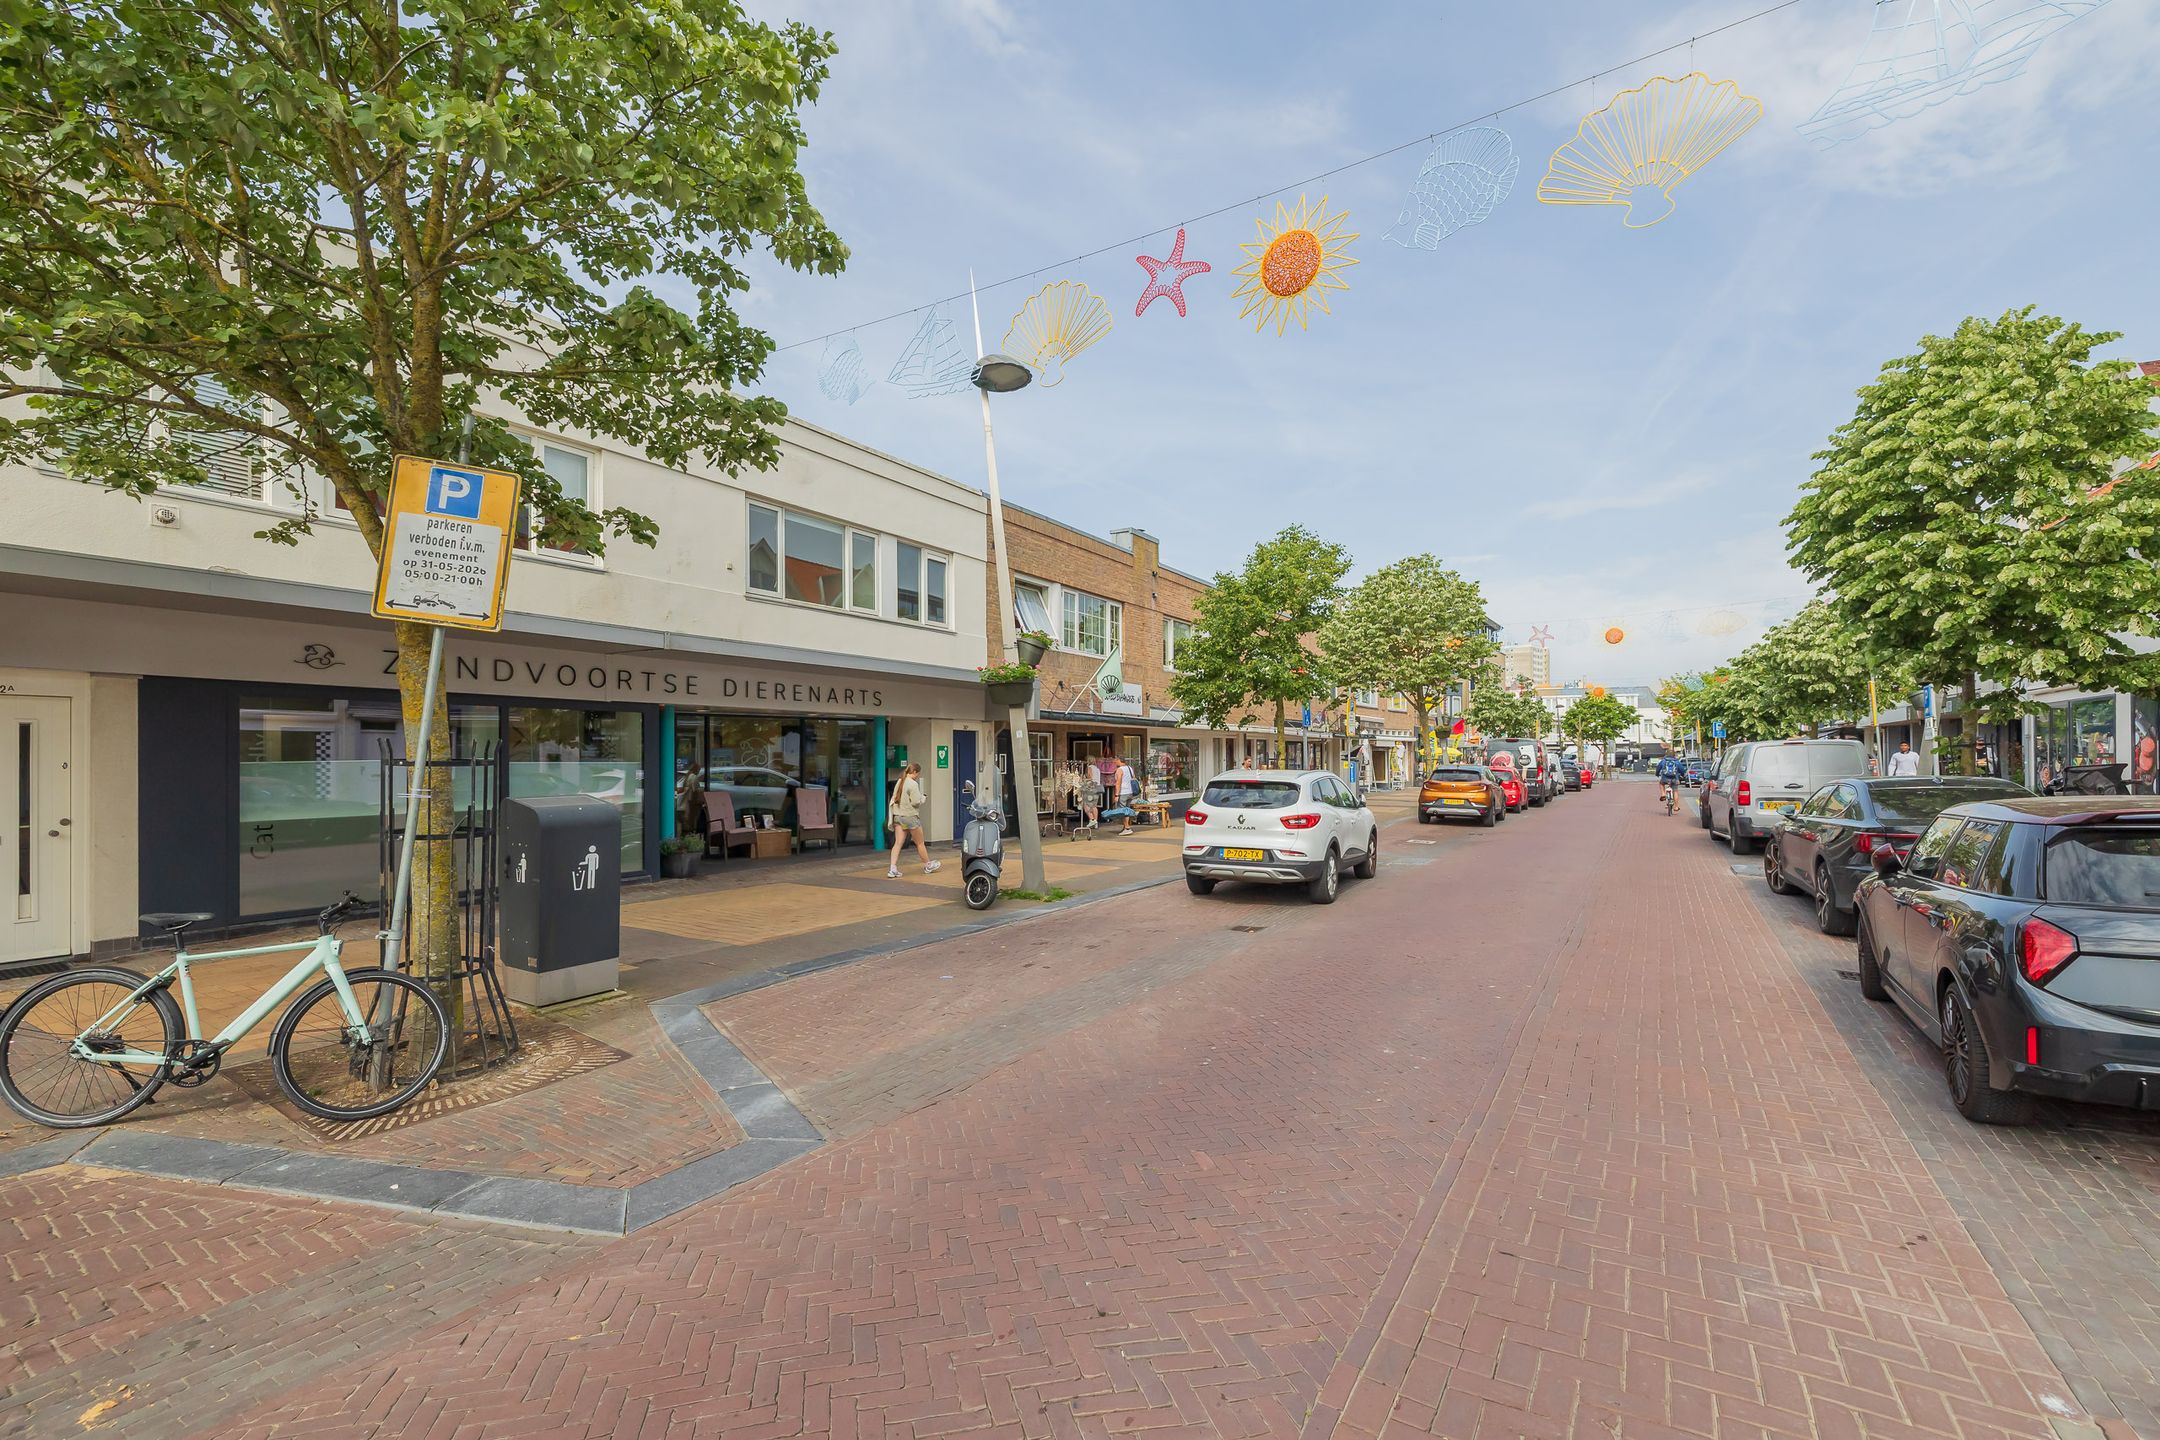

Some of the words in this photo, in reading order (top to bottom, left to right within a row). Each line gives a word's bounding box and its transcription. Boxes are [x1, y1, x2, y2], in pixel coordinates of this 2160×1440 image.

[438, 474, 471, 510] P
[427, 518, 473, 534] parkeren
[409, 533, 457, 550] verboden
[403, 559, 418, 568] op
[414, 549, 478, 563] evenement
[382, 649, 699, 695] ZNDVOORTSE
[723, 678, 883, 707] DIERENARTS
[250, 824, 274, 860] Cat
